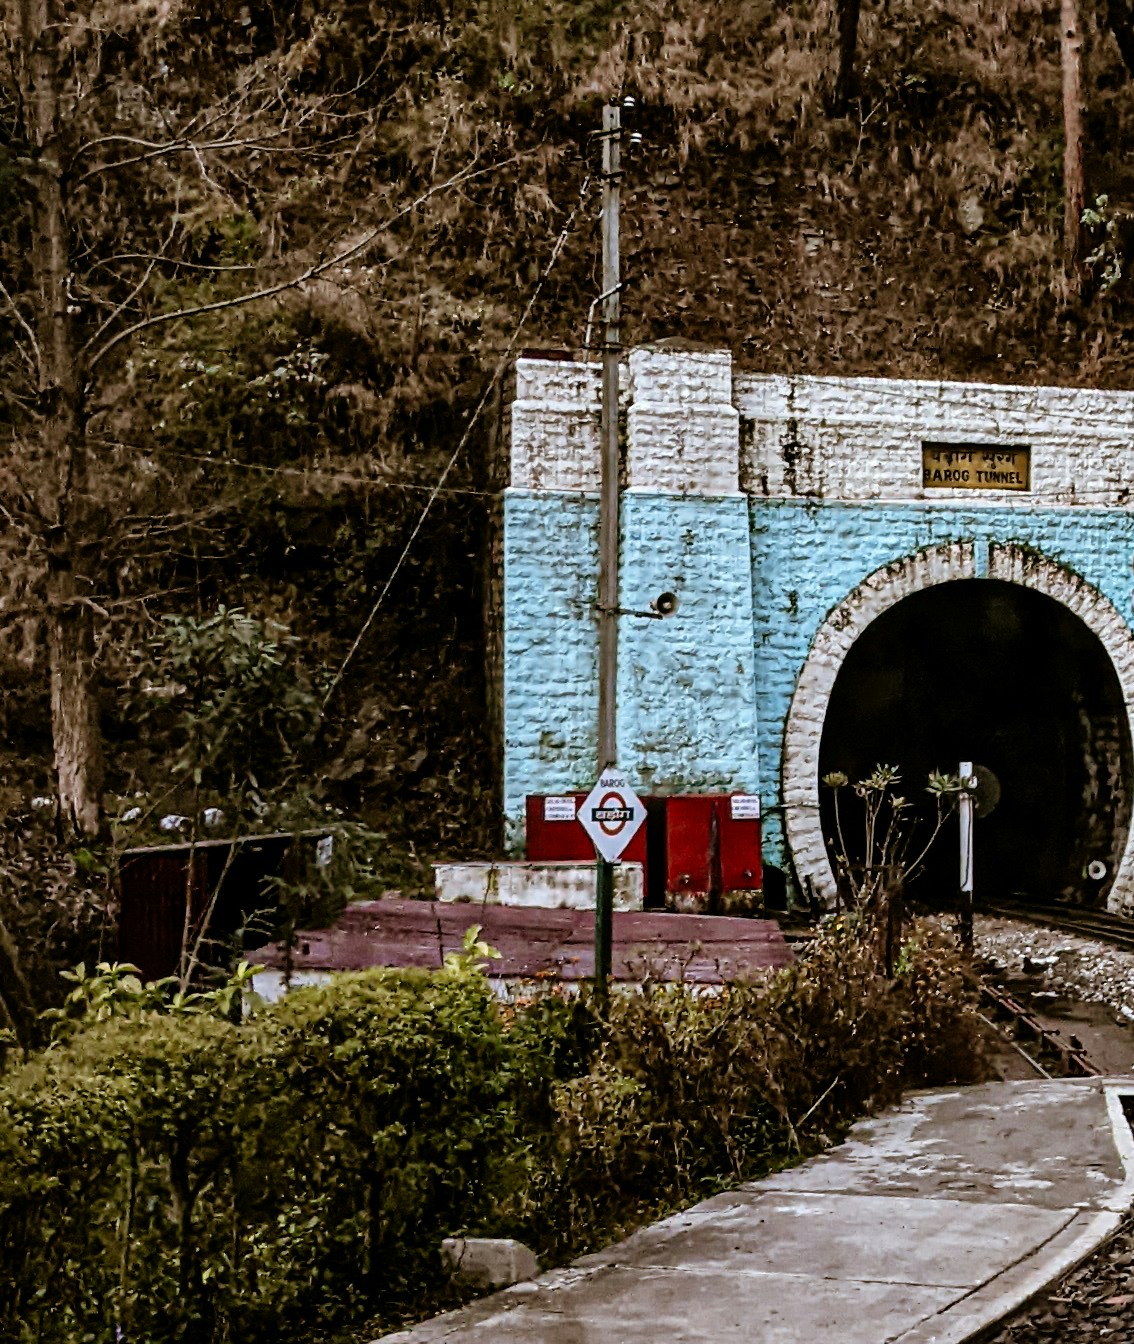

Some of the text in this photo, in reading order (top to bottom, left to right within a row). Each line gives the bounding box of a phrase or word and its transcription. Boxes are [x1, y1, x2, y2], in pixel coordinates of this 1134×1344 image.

[923, 469, 1023, 484] BAROG TUNNEL
[600, 778, 625, 788] BAROG
